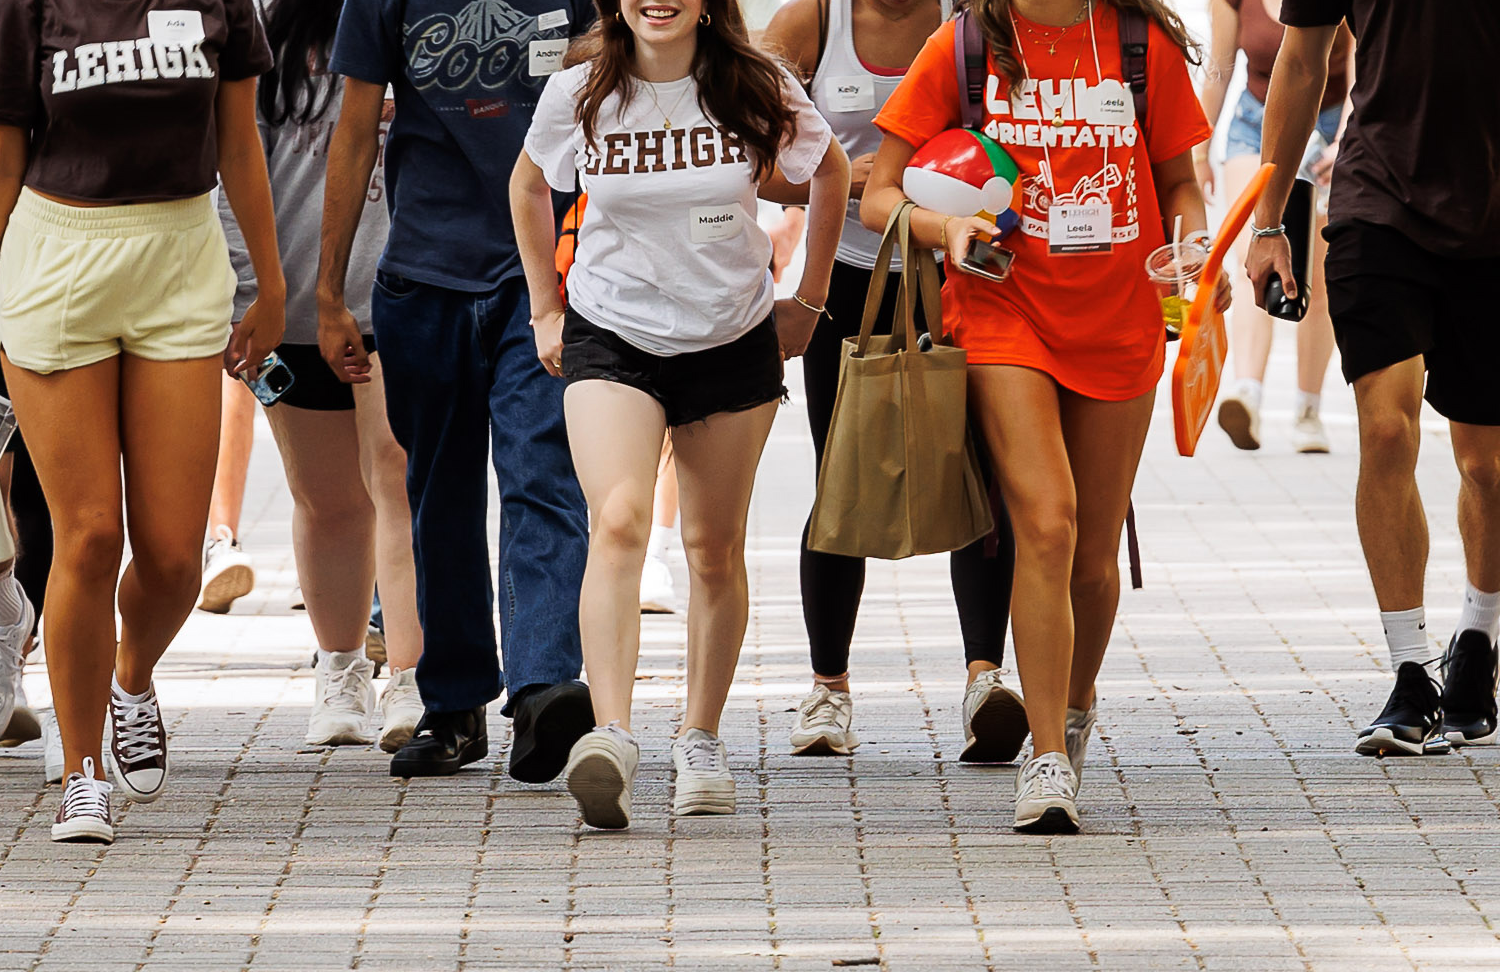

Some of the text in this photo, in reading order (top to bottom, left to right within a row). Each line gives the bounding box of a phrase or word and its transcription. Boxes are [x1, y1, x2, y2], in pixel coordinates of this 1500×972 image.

[403, 12, 542, 91] Coo
[838, 85, 860, 94] Kelly
[985, 119, 1138, 148] ORIENTATIO
[699, 213, 734, 224] Maddie
[1067, 224, 1092, 232] Leela
